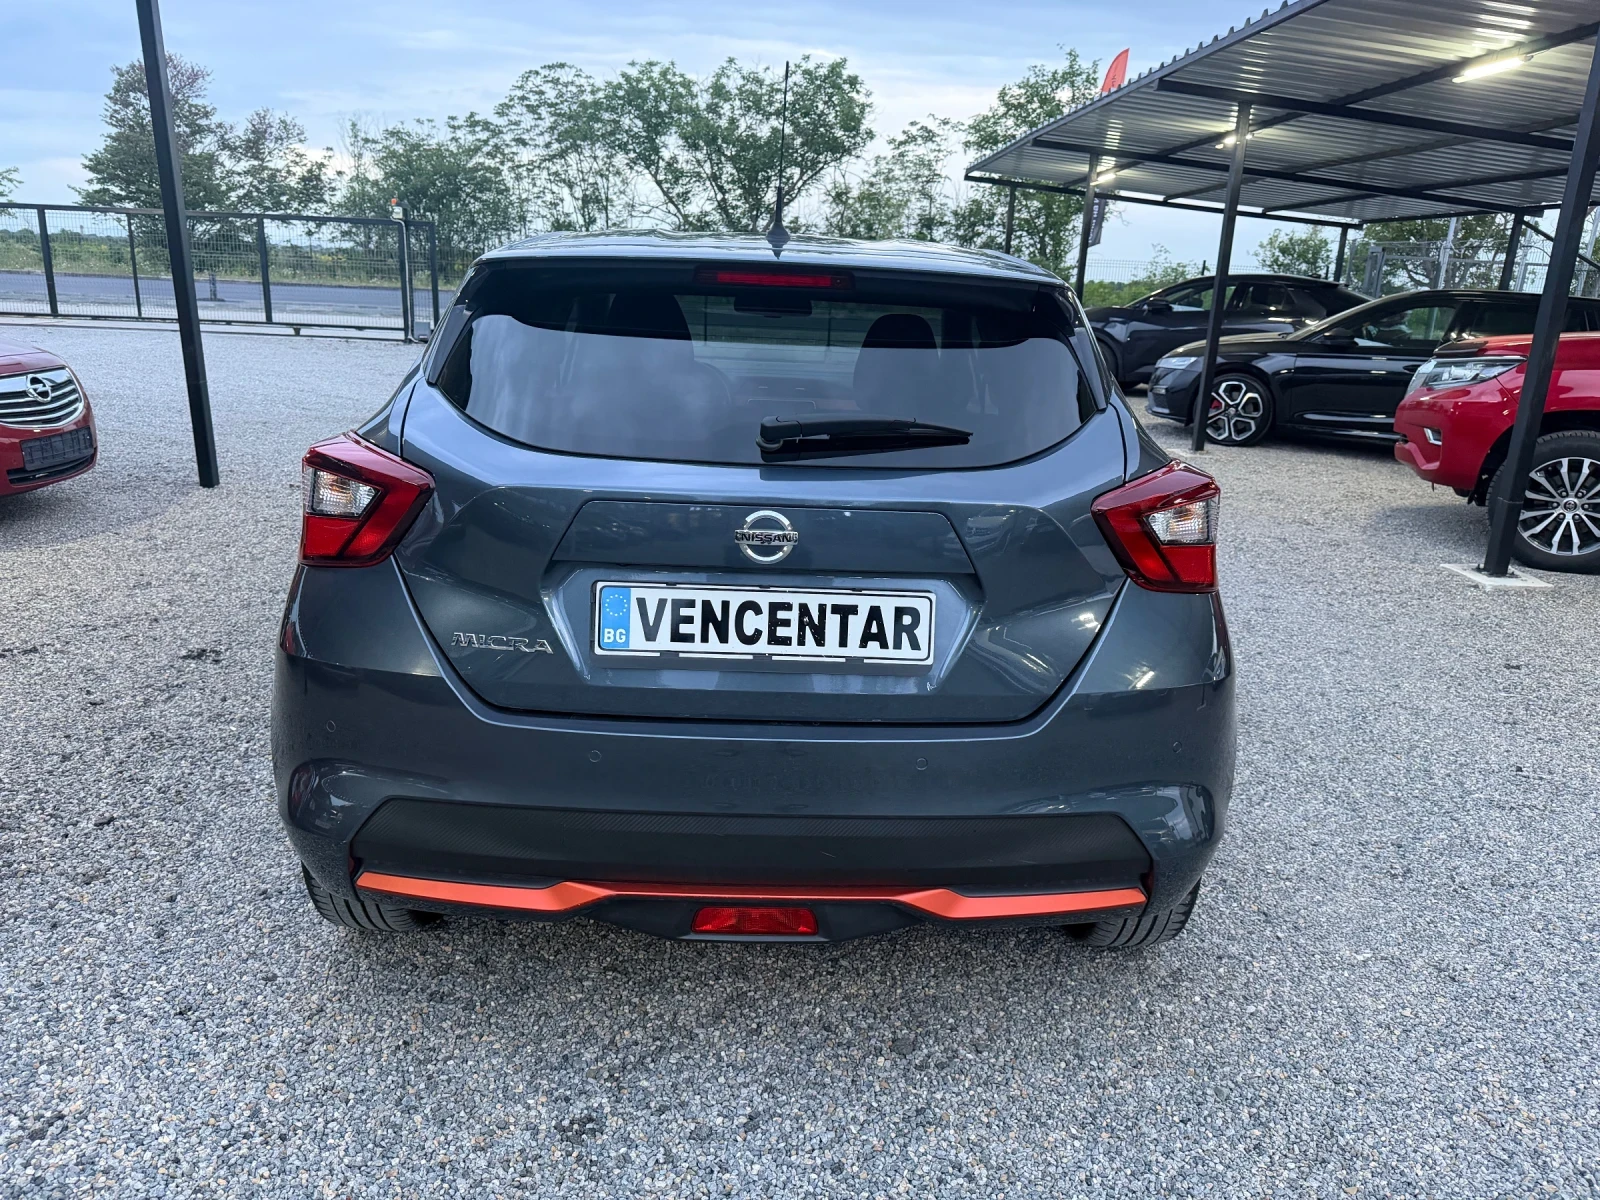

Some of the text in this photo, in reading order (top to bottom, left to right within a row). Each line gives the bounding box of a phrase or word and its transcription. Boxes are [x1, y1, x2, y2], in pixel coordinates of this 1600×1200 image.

[740, 532, 792, 543] NISSAN
[636, 597, 921, 651] VENCENTAR
[450, 632, 554, 654] MICRA
[603, 628, 627, 643] BG
